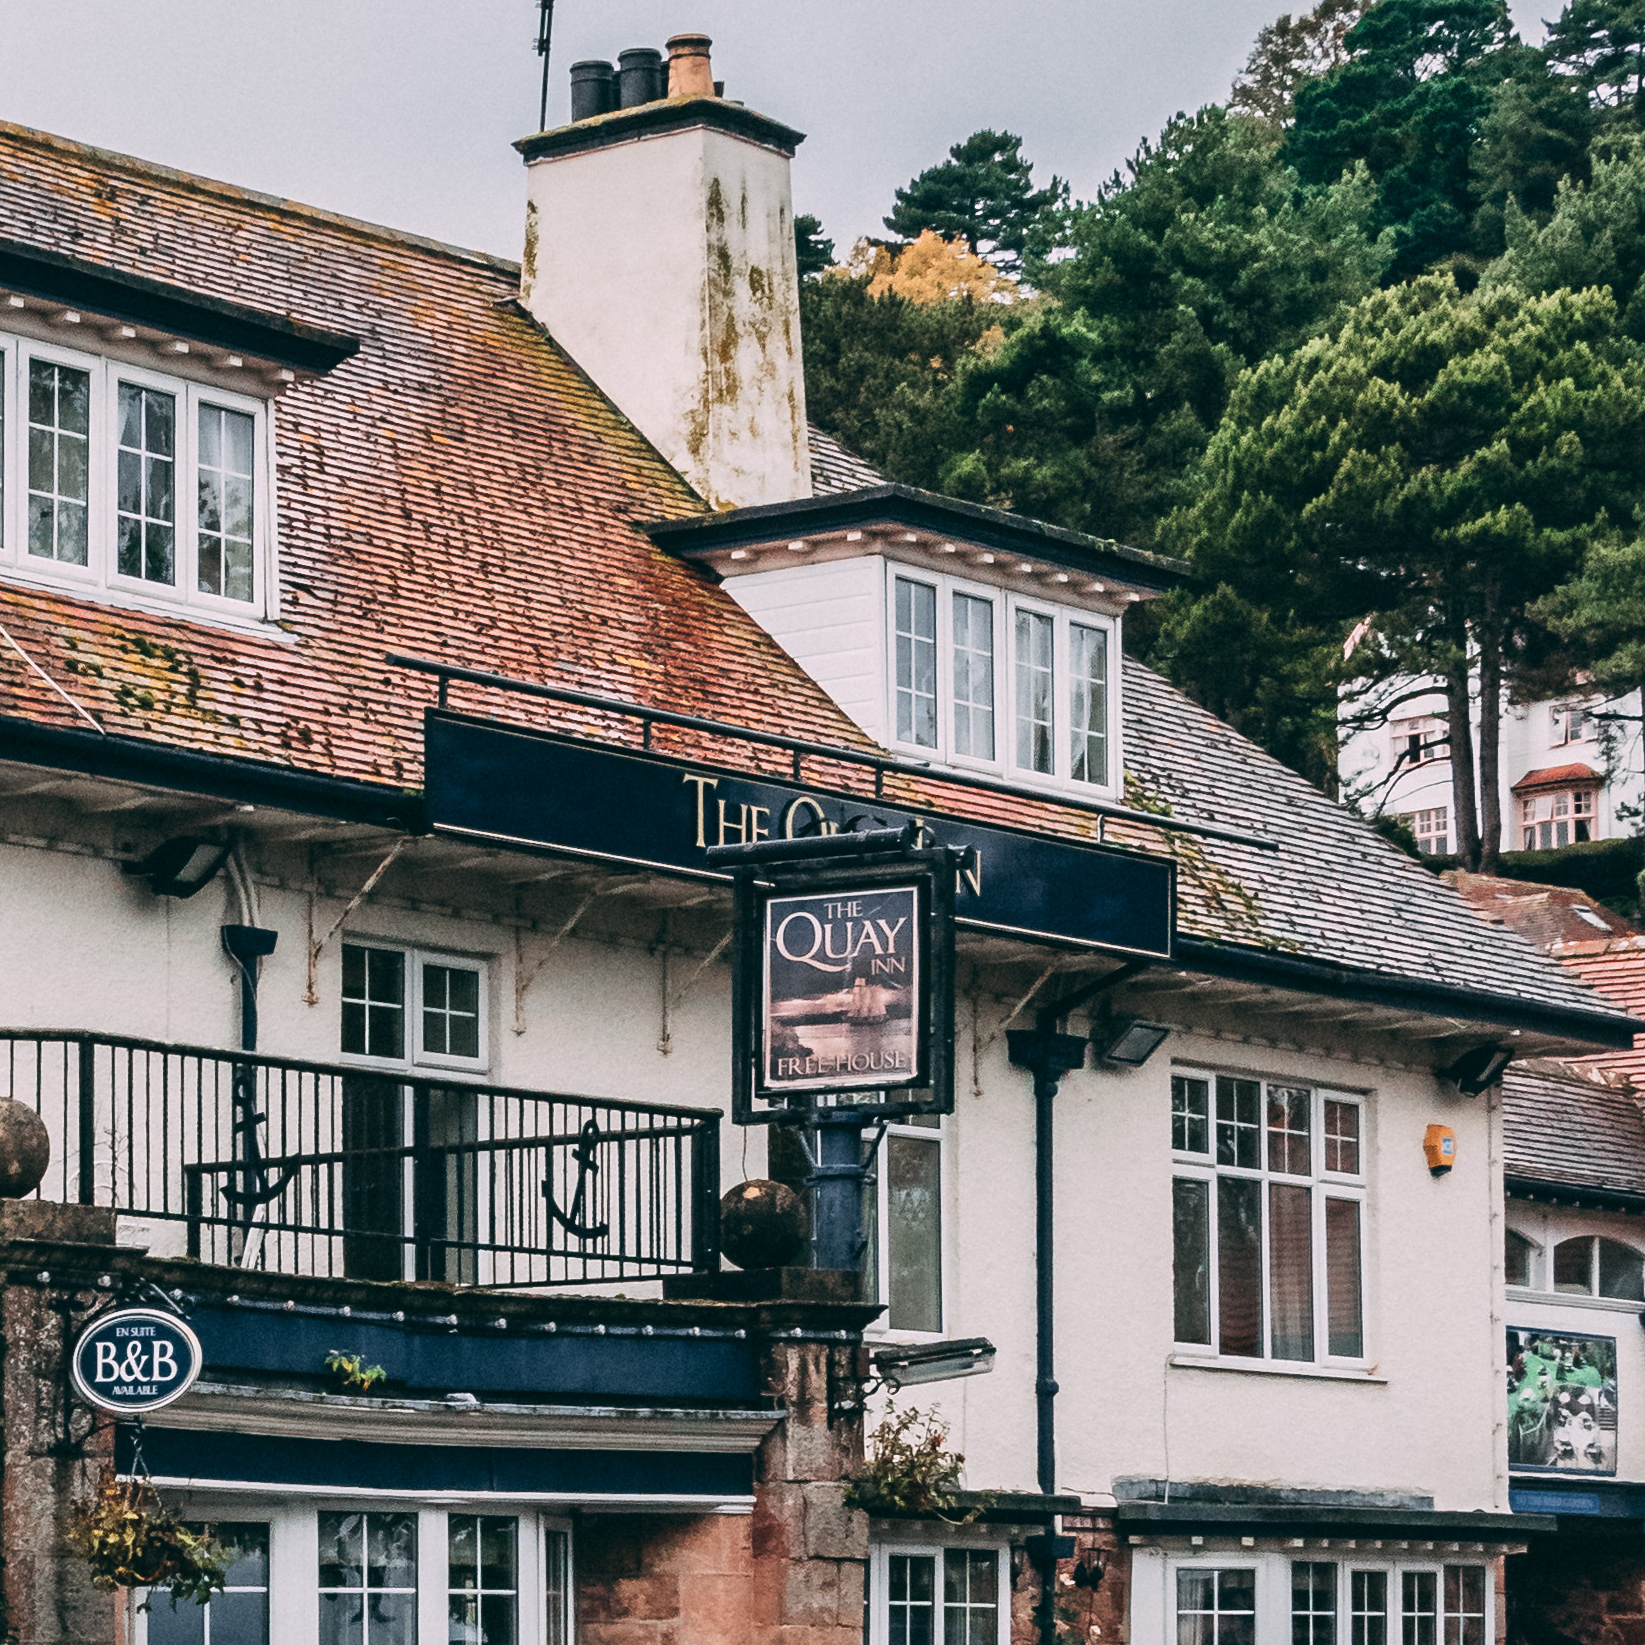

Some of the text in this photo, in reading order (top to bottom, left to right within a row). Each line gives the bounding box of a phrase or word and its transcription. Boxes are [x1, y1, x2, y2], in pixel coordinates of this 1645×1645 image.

[682, 772, 771, 848] THE
[824, 900, 864, 920] THE
[775, 911, 908, 973] QUAY
[870, 956, 906, 976] INN
[777, 1051, 906, 1076] FREE HOUSE
[116, 1326, 156, 1337] EN SUITE
[94, 1340, 178, 1383] B&B
[112, 1385, 158, 1395] AVAILABLE
